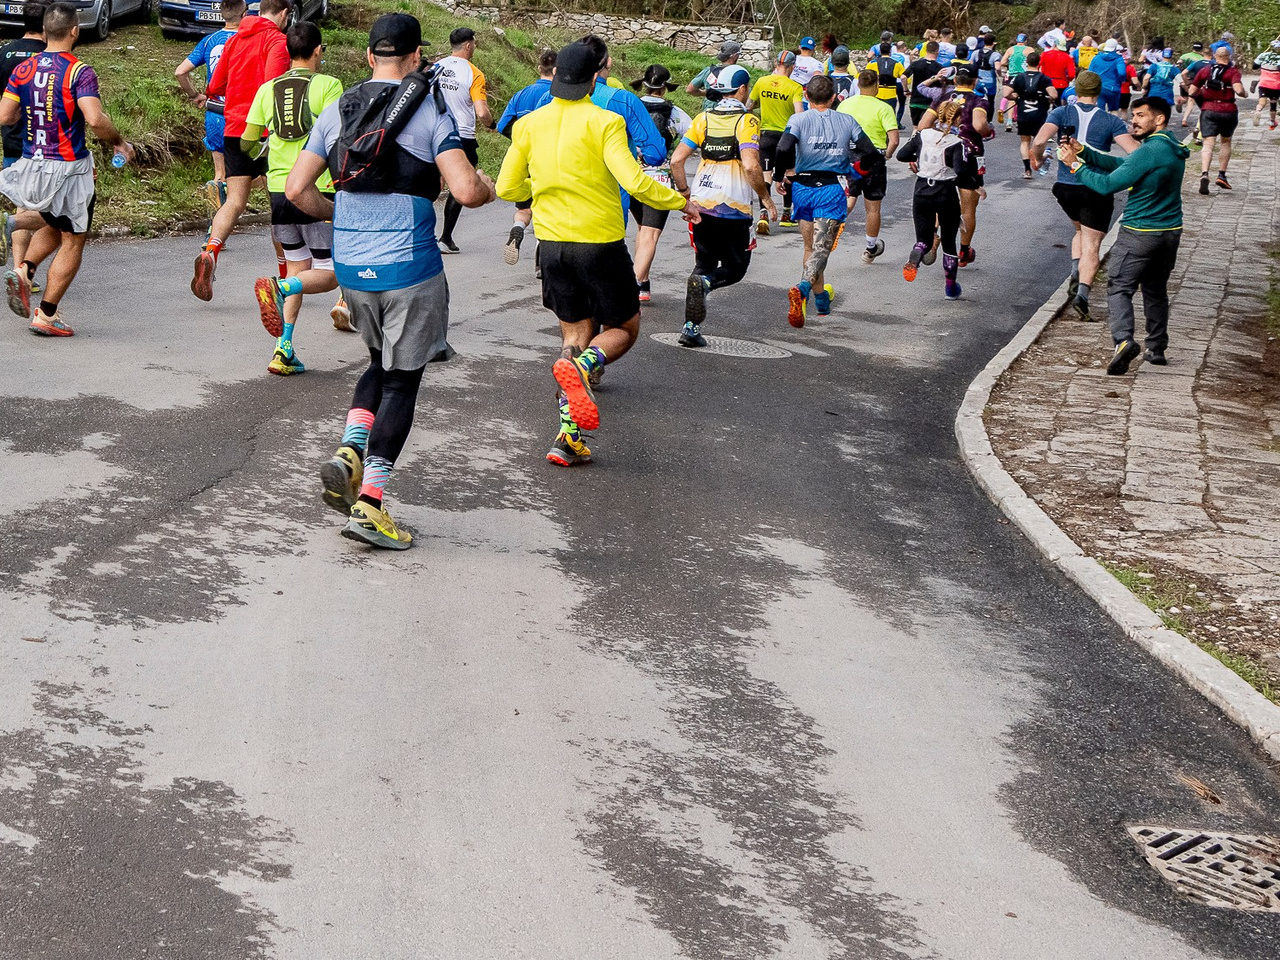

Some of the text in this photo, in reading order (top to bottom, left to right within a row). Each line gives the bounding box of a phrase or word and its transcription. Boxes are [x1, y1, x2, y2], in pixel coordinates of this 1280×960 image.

[32, 71, 49, 160] ULTRA
[284, 87, 295, 127] UTOBEST
[386, 81, 417, 124] SALOMON
[761, 90, 790, 102] CREW
